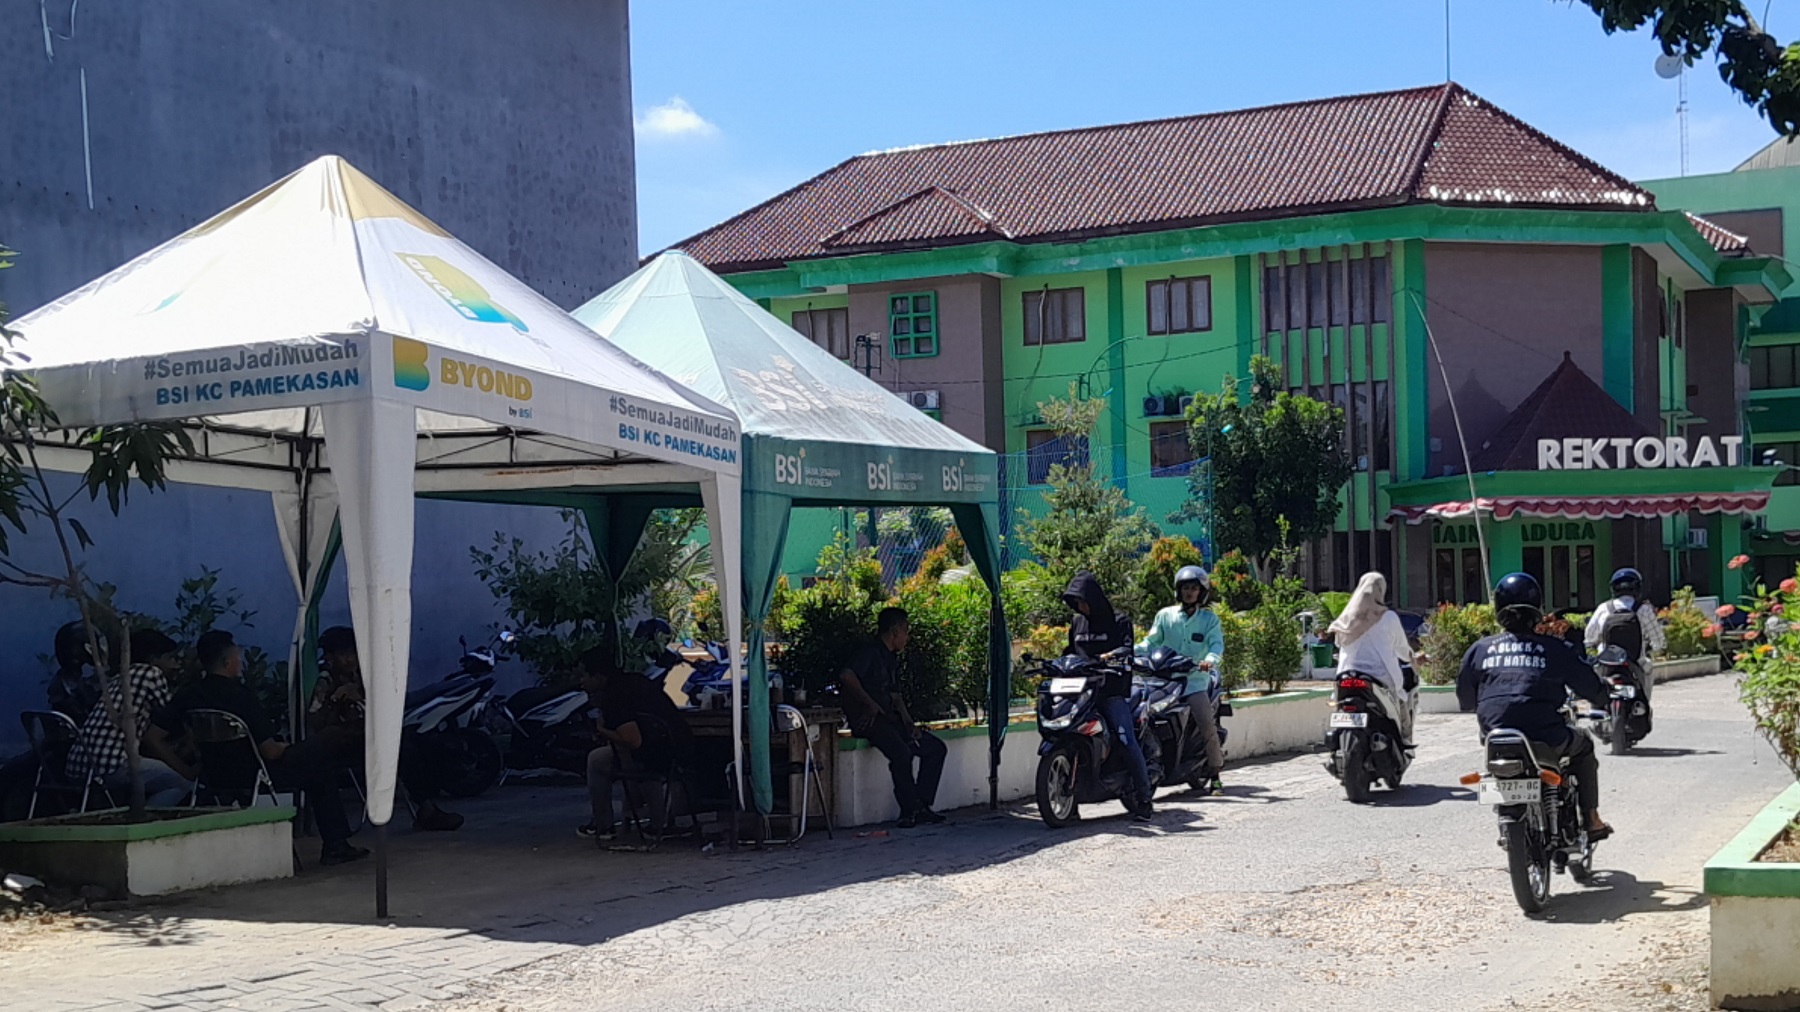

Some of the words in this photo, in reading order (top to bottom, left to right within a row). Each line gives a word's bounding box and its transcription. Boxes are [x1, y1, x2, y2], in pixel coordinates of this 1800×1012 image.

[144, 338, 359, 382] #SemuaJadiMudah
[156, 380, 190, 405] BSI
[194, 377, 226, 402] KC
[230, 367, 359, 398] PAMEKASAN
[440, 357, 533, 402] BYOND
[509, 405, 518, 418] by
[608, 394, 738, 443] #SemuaJadiMudah
[618, 422, 642, 445] BSI
[645, 427, 661, 447] KC
[663, 431, 737, 464] PAMEKASAN
[1538, 435, 1743, 470] REKTORAT
[774, 451, 803, 485] BSI
[867, 459, 891, 491] BSI
[941, 463, 963, 492] BSI
